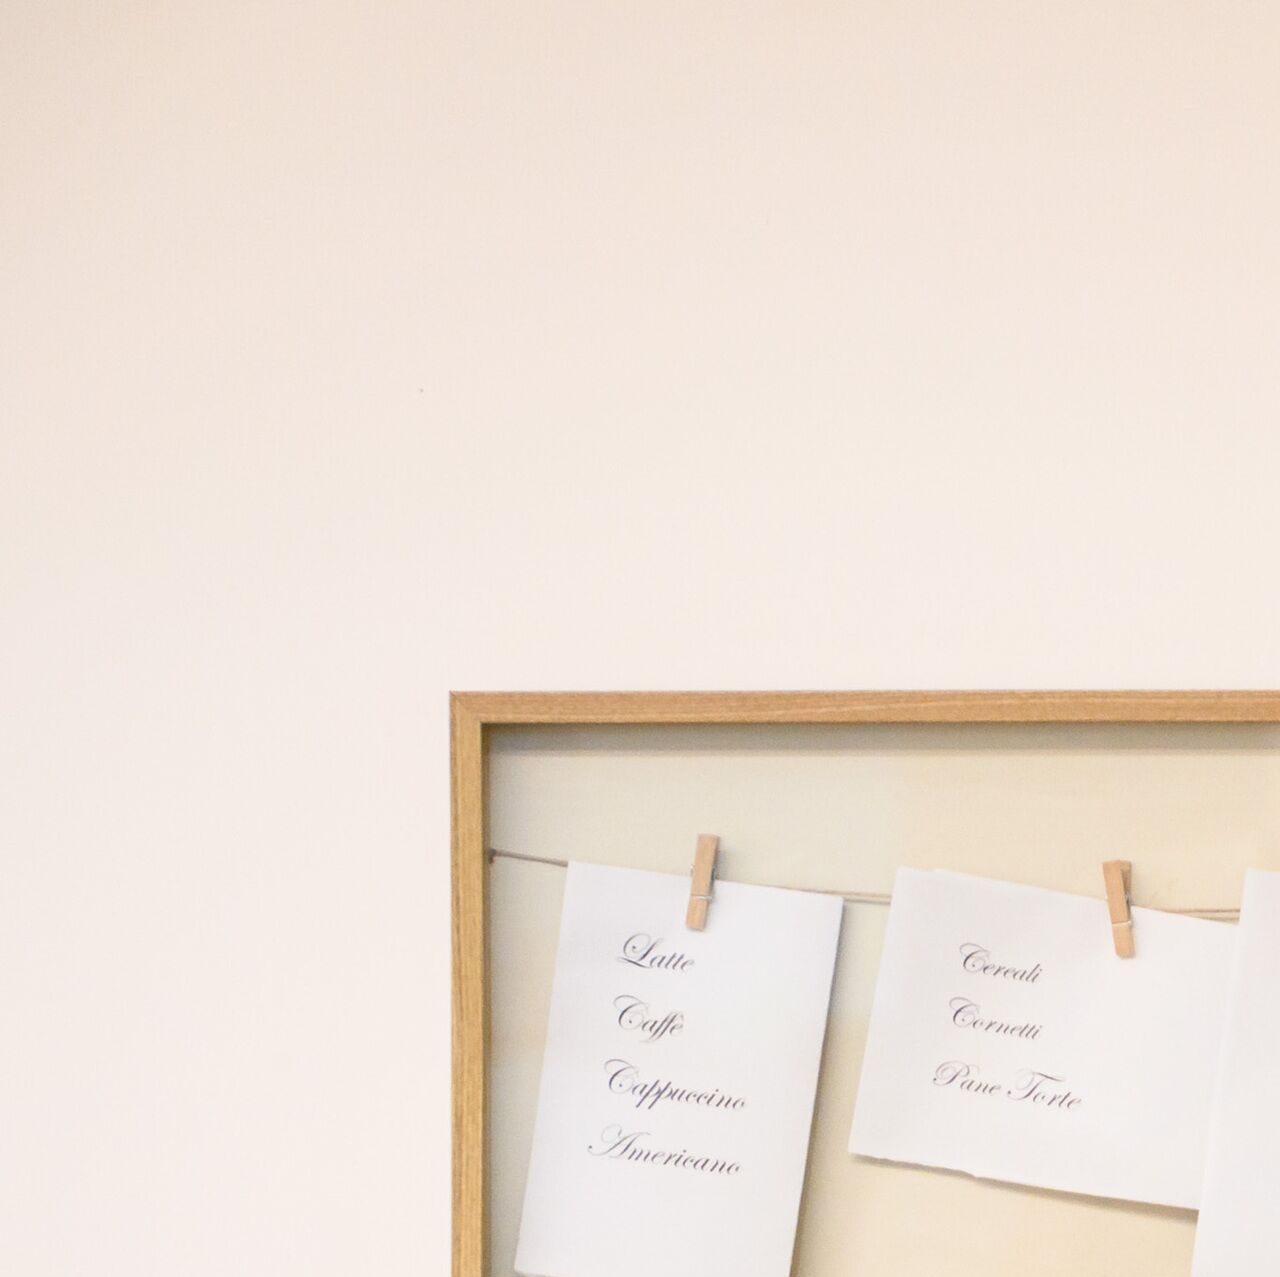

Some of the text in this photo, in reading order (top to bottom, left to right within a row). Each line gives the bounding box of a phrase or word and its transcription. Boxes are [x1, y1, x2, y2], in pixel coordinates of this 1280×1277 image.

[616, 932, 695, 973] Latte
[958, 942, 1043, 984] Cereali
[613, 994, 685, 1043] Caffè
[948, 996, 1043, 1041] Cornetti
[603, 1058, 747, 1110] Cappuccino
[932, 1060, 1083, 1111] Pane Torte
[587, 1123, 742, 1176] Americano
